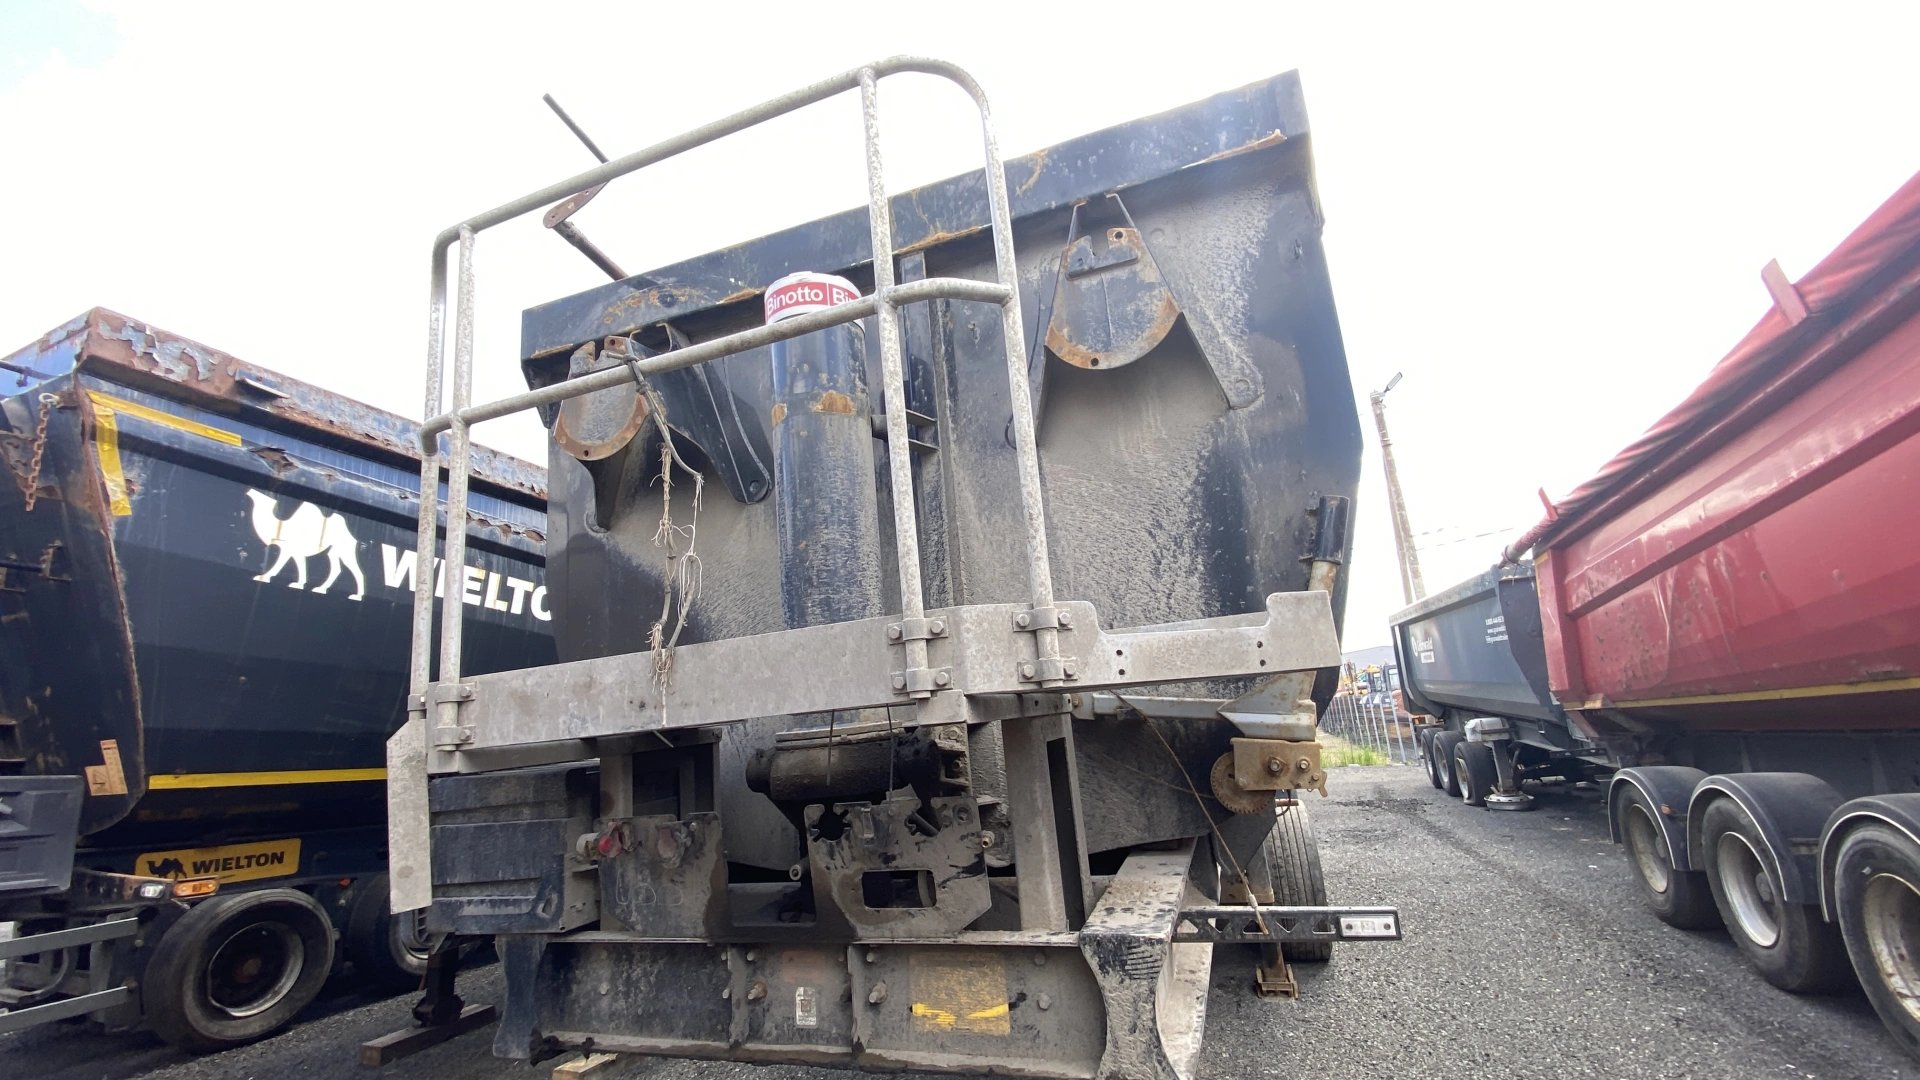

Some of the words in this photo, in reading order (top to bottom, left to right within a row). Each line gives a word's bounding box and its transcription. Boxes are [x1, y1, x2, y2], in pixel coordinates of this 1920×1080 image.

[767, 285, 824, 314] Binotto
[381, 543, 552, 621] WIELTO
[192, 851, 285, 874] WIELTON
